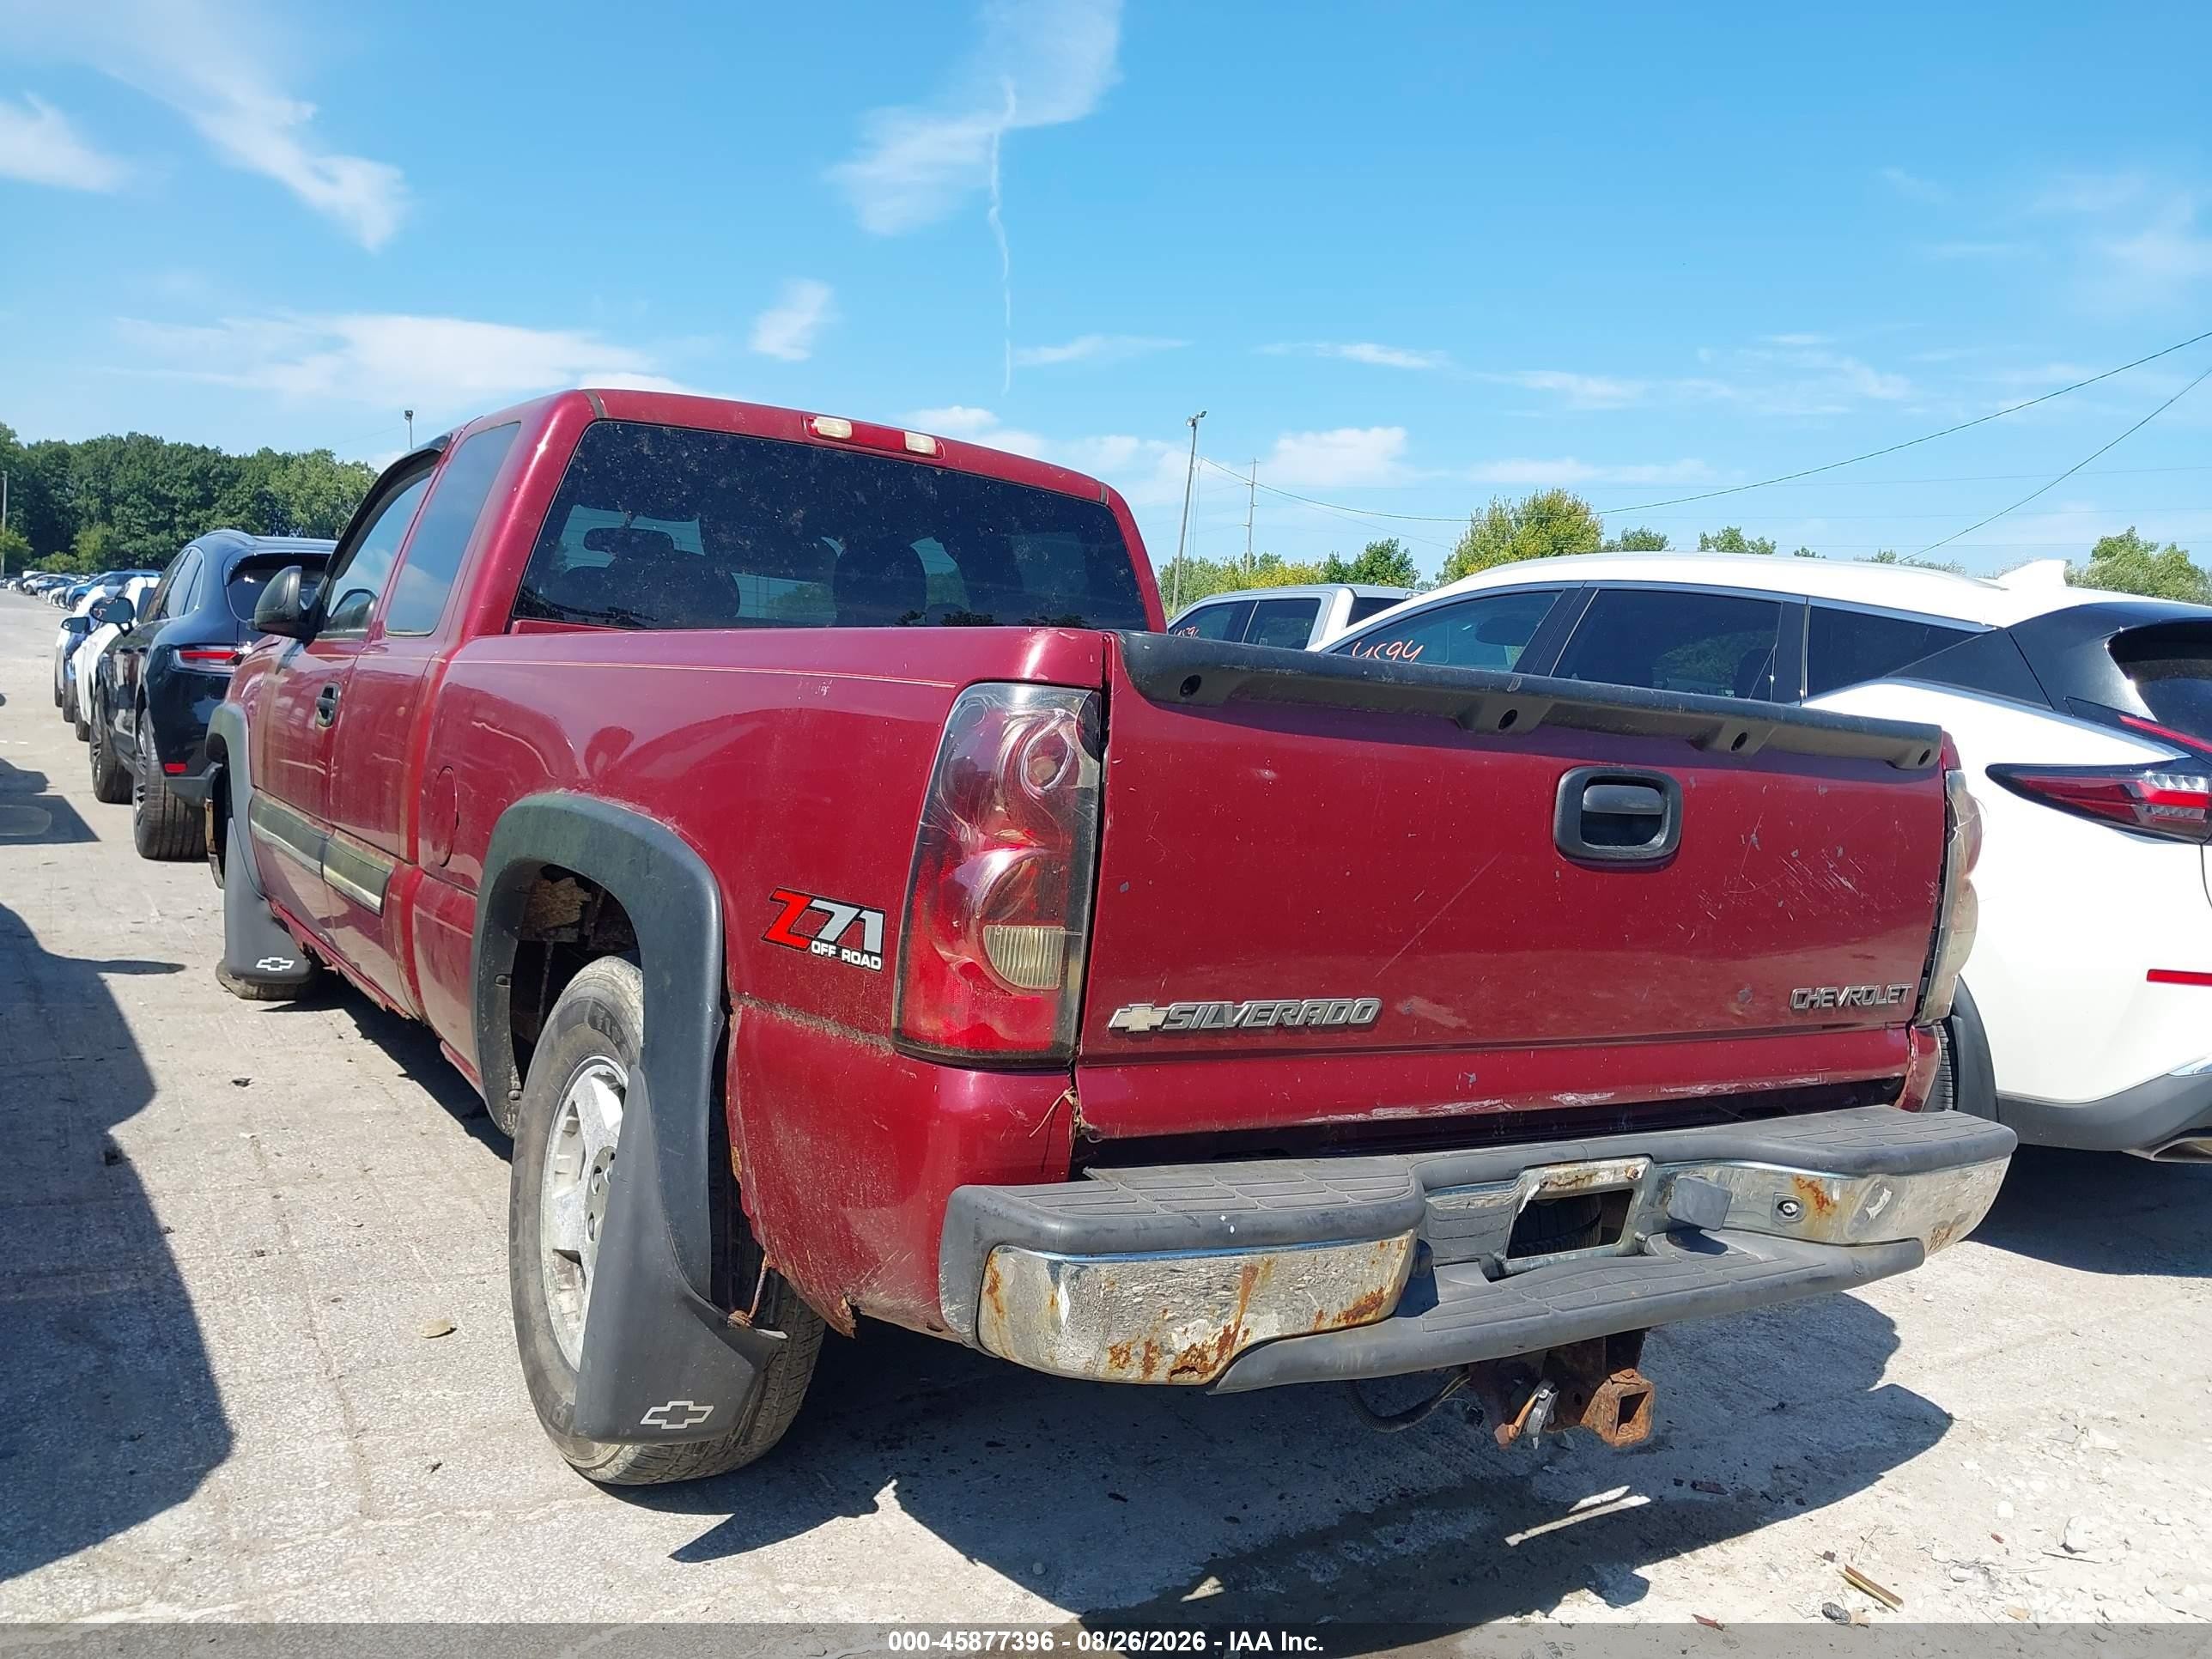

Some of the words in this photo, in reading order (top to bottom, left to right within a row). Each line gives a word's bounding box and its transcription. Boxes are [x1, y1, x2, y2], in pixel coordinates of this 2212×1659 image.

[763, 886, 885, 954] Z71
[811, 940, 837, 958] OFF
[841, 949, 882, 971] ROAD
[1790, 983, 1913, 1010] CHEVROLET
[1162, 998, 1382, 1030] SILVERADO
